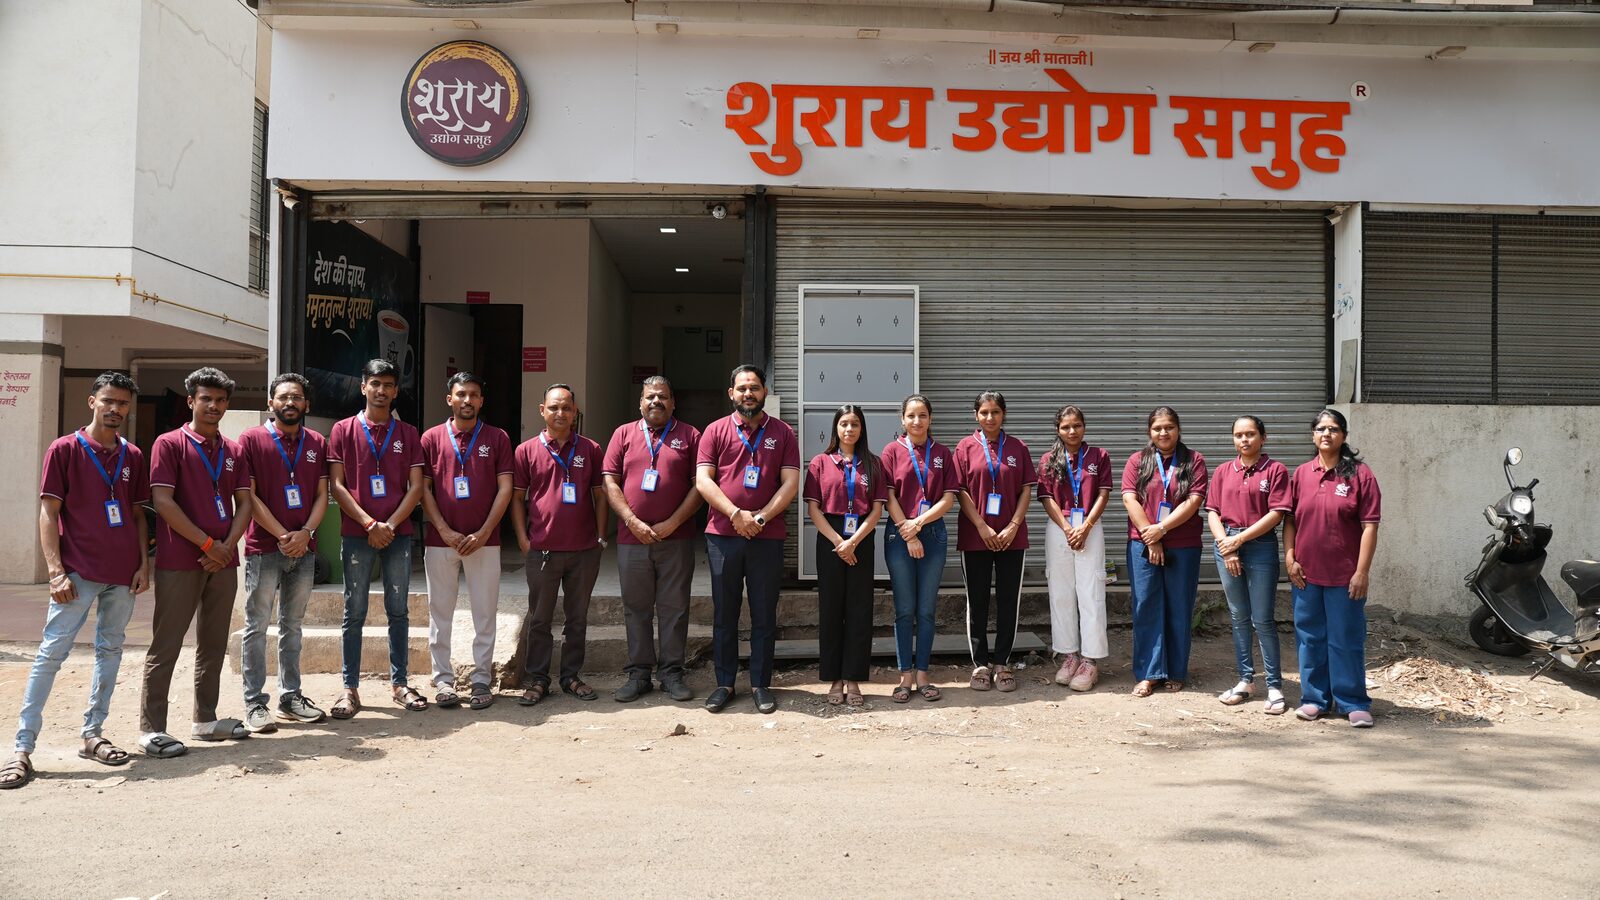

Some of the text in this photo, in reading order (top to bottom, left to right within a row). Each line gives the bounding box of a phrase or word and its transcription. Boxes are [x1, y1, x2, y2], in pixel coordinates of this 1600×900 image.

[999, 52, 1021, 64] जय
[1024, 49, 1041, 64] श्री
[1043, 51, 1087, 65] माताजी
[430, 130, 492, 149] उद्योग समुह
[725, 68, 1351, 190] शुराय उद्योग समुह
[314, 251, 366, 293] देश की चाय,
